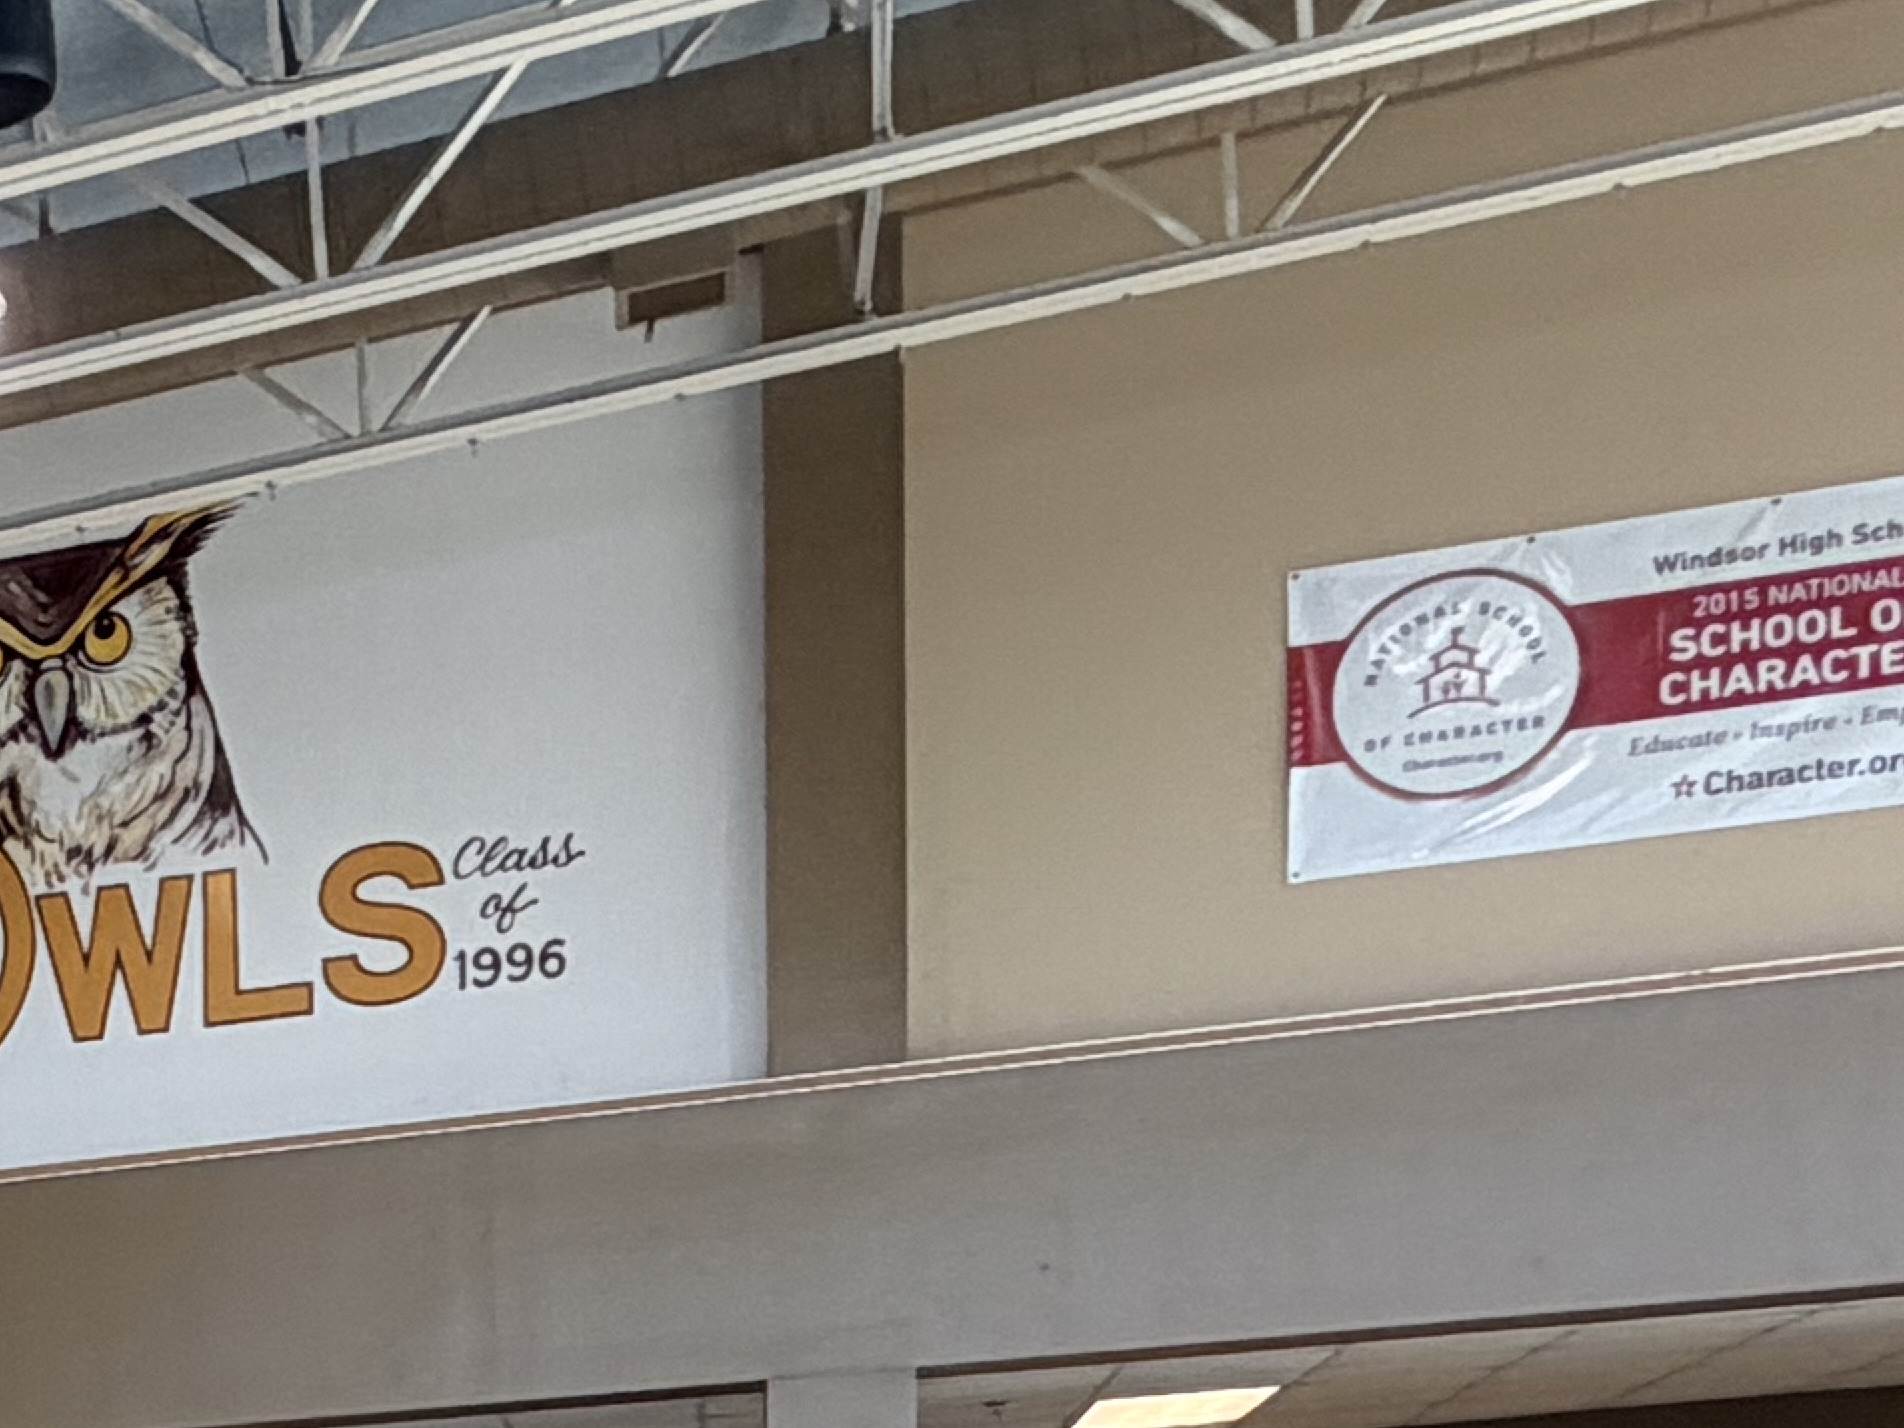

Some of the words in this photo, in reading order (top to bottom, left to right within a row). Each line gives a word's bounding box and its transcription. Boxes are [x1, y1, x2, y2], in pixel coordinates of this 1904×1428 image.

[1653, 543, 1770, 575] Windsor
[1779, 529, 1842, 556] High
[1693, 587, 1760, 618] 2015
[1768, 567, 1904, 606] NATIONAL
[1478, 600, 1546, 664] SCHOOL
[1669, 606, 1857, 662] SCHOOL
[1870, 598, 1904, 632] O
[1364, 736, 1391, 753] OF
[1403, 715, 1545, 747] CHARACTER
[1628, 730, 1729, 756] Educate
[1750, 713, 1838, 741] Inspire
[453, 832, 586, 880] Class
[479, 881, 540, 934] of
[452, 938, 566, 991] 1996
